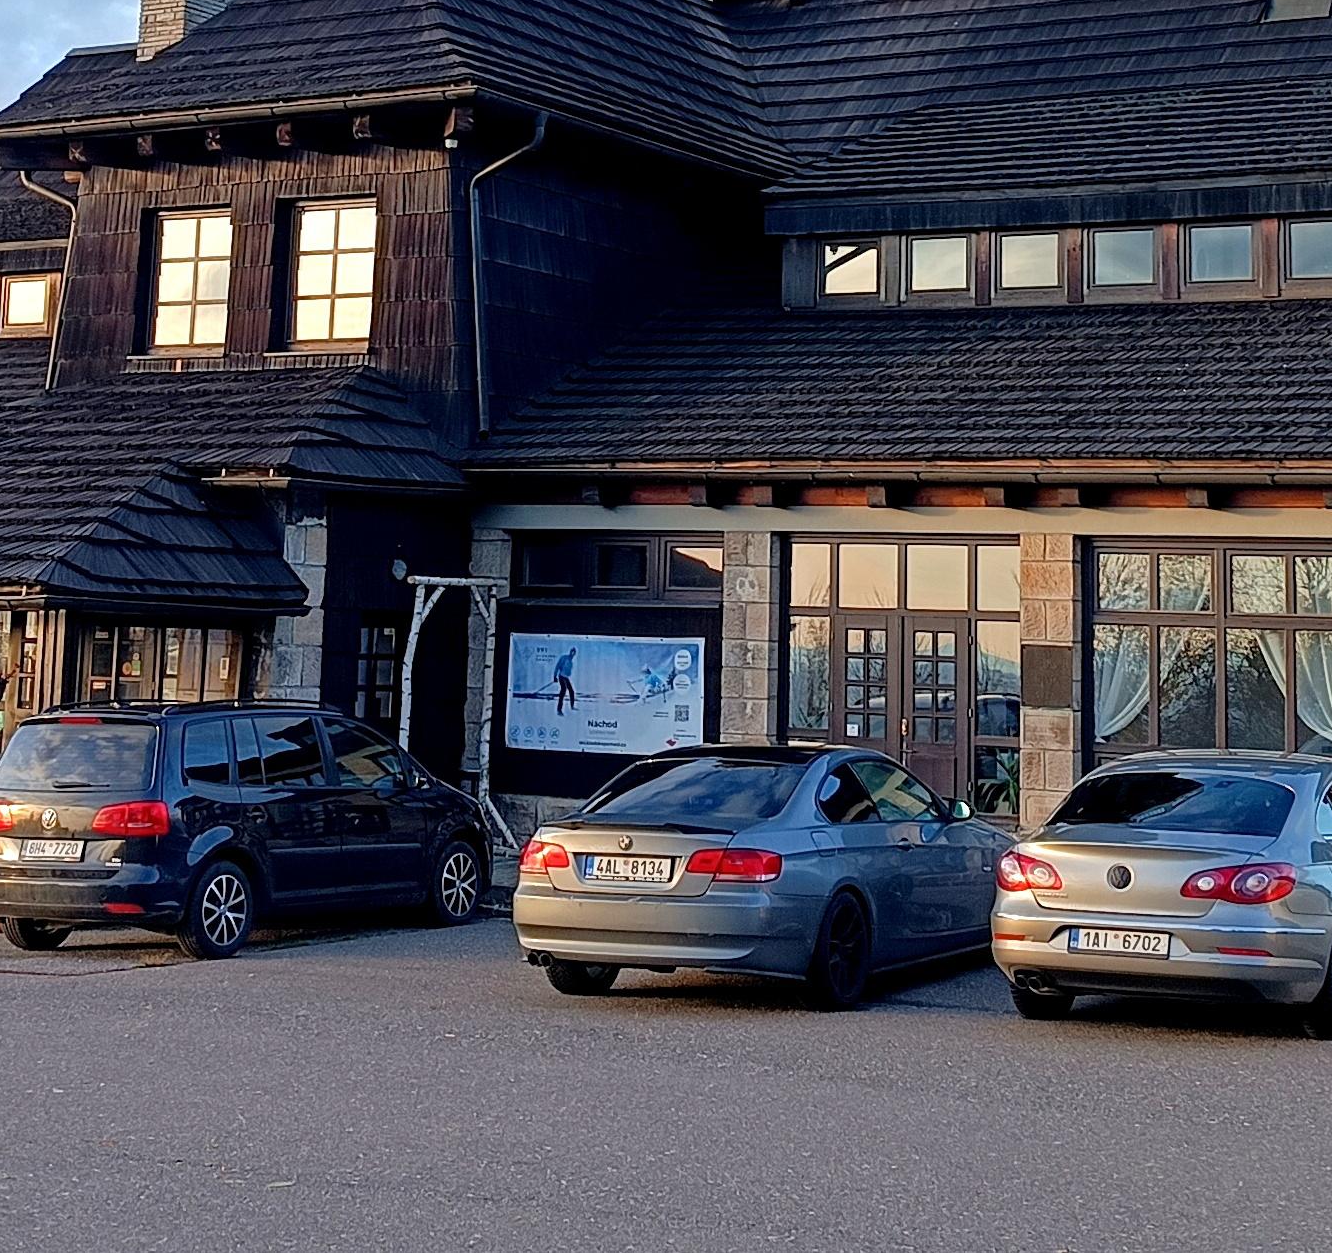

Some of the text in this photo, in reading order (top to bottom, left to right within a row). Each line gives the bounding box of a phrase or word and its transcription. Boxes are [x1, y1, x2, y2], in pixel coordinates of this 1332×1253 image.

[52, 842, 79, 855] 7720
[596, 858, 620, 875] 4AL
[630, 860, 664, 876] 8134
[1083, 931, 1108, 948] 1AI
[1122, 934, 1162, 952] 6702
